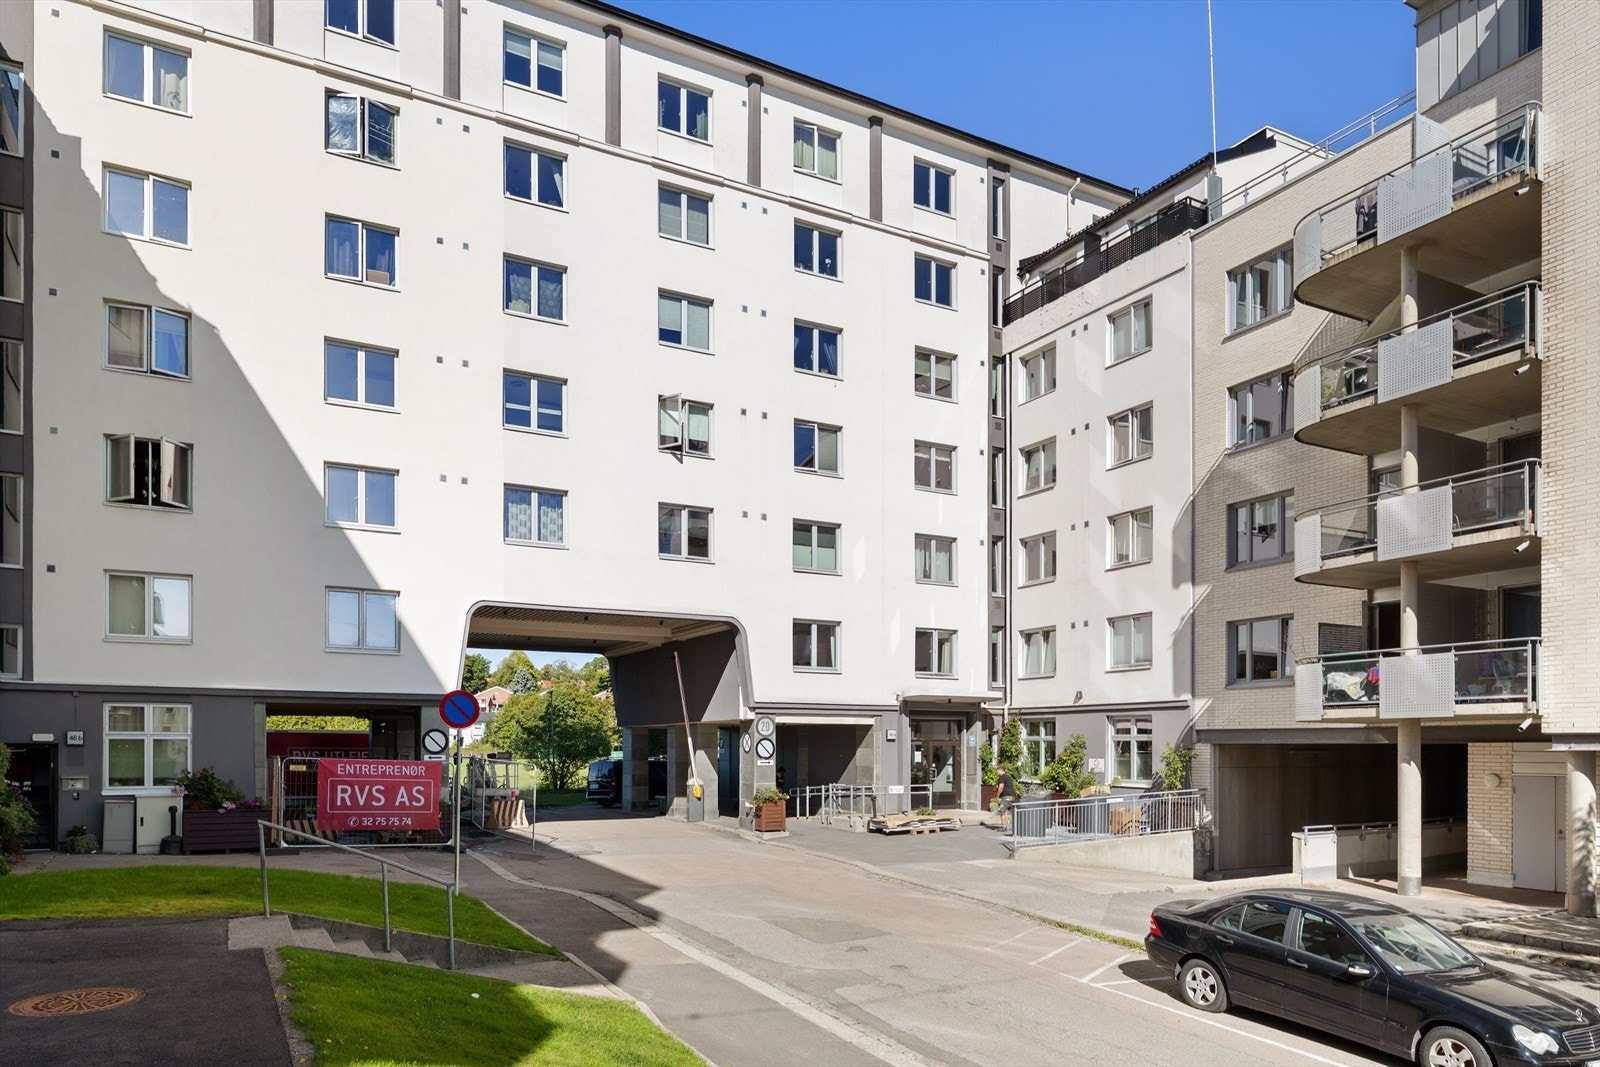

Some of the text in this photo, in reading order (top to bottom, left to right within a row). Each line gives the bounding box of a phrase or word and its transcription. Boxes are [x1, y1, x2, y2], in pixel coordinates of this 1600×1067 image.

[760, 721, 770, 731] 20
[337, 763, 426, 776] ENTREPRENØR
[336, 785, 425, 807] RVS AS
[361, 817, 412, 826] 32 75 75 74
